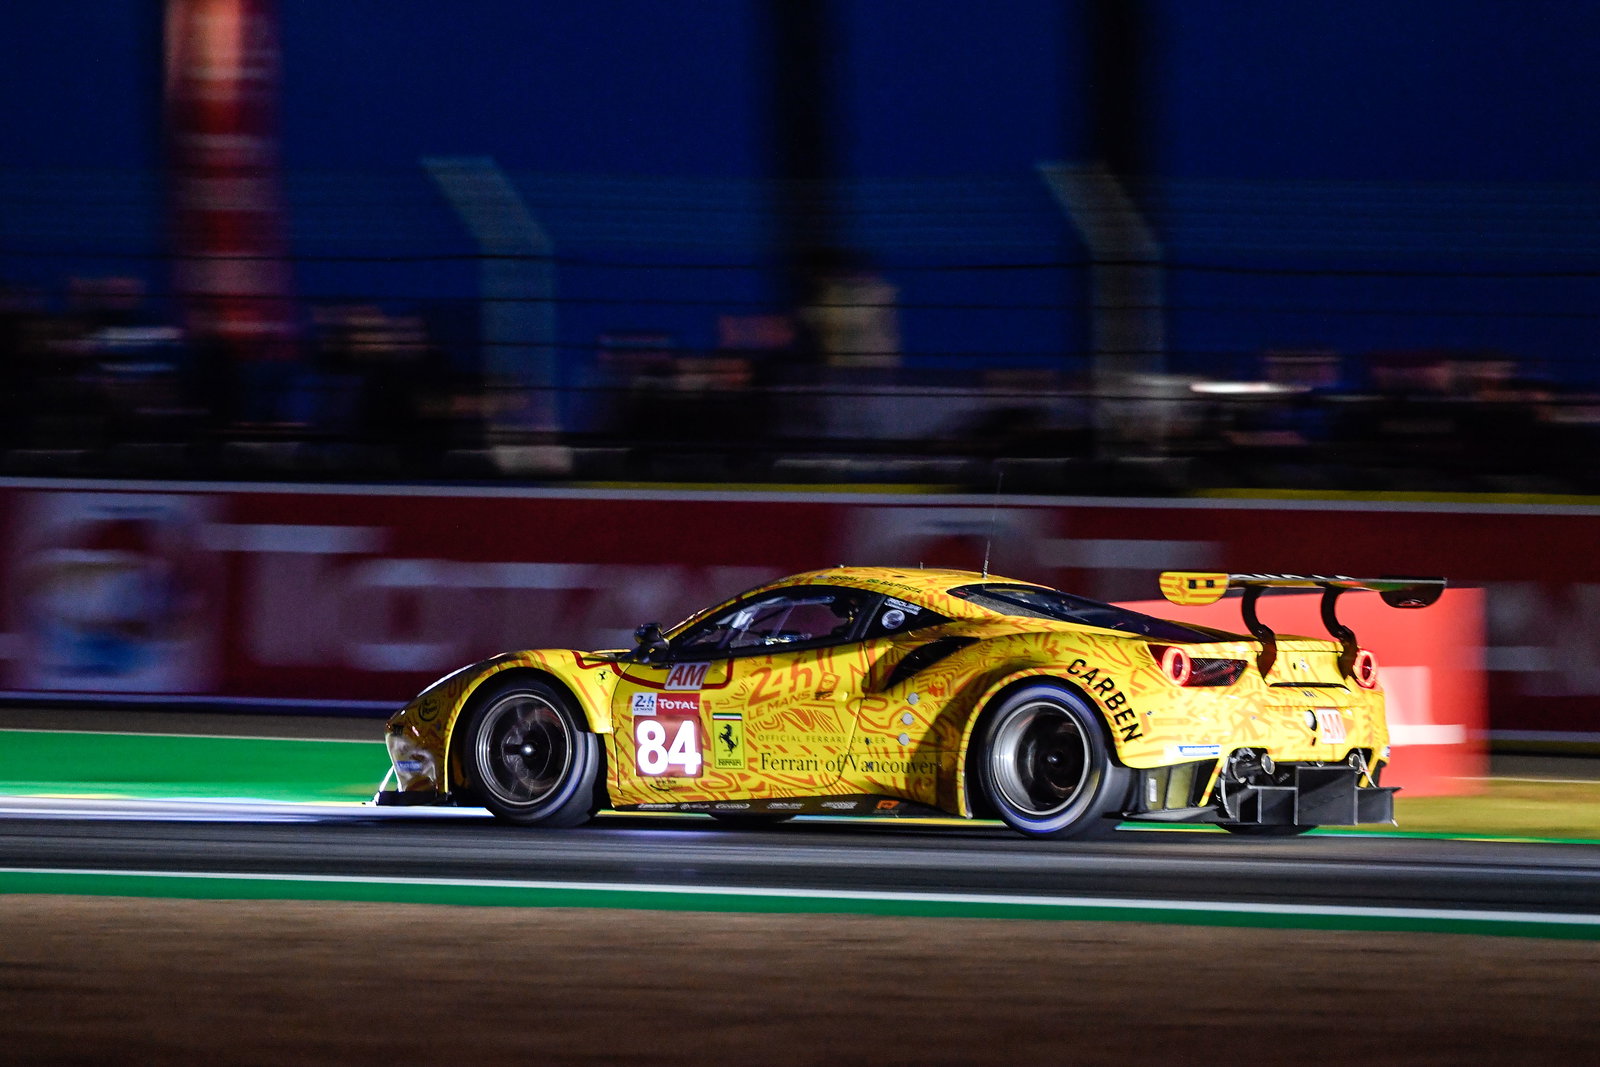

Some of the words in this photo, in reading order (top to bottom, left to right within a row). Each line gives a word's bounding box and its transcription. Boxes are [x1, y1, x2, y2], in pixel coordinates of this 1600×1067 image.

[667, 664, 706, 687] AM
[658, 699, 698, 710] TOTAL
[768, 691, 811, 712] MANS
[1066, 658, 1143, 743] CARBEN
[636, 719, 702, 775] 84
[758, 734, 801, 742] OFFICIAL
[806, 735, 847, 743] FERRARI
[851, 736, 886, 744] DELER
[761, 752, 818, 771] Ferrari
[825, 754, 844, 773] of
[848, 754, 939, 774] Vancouver
